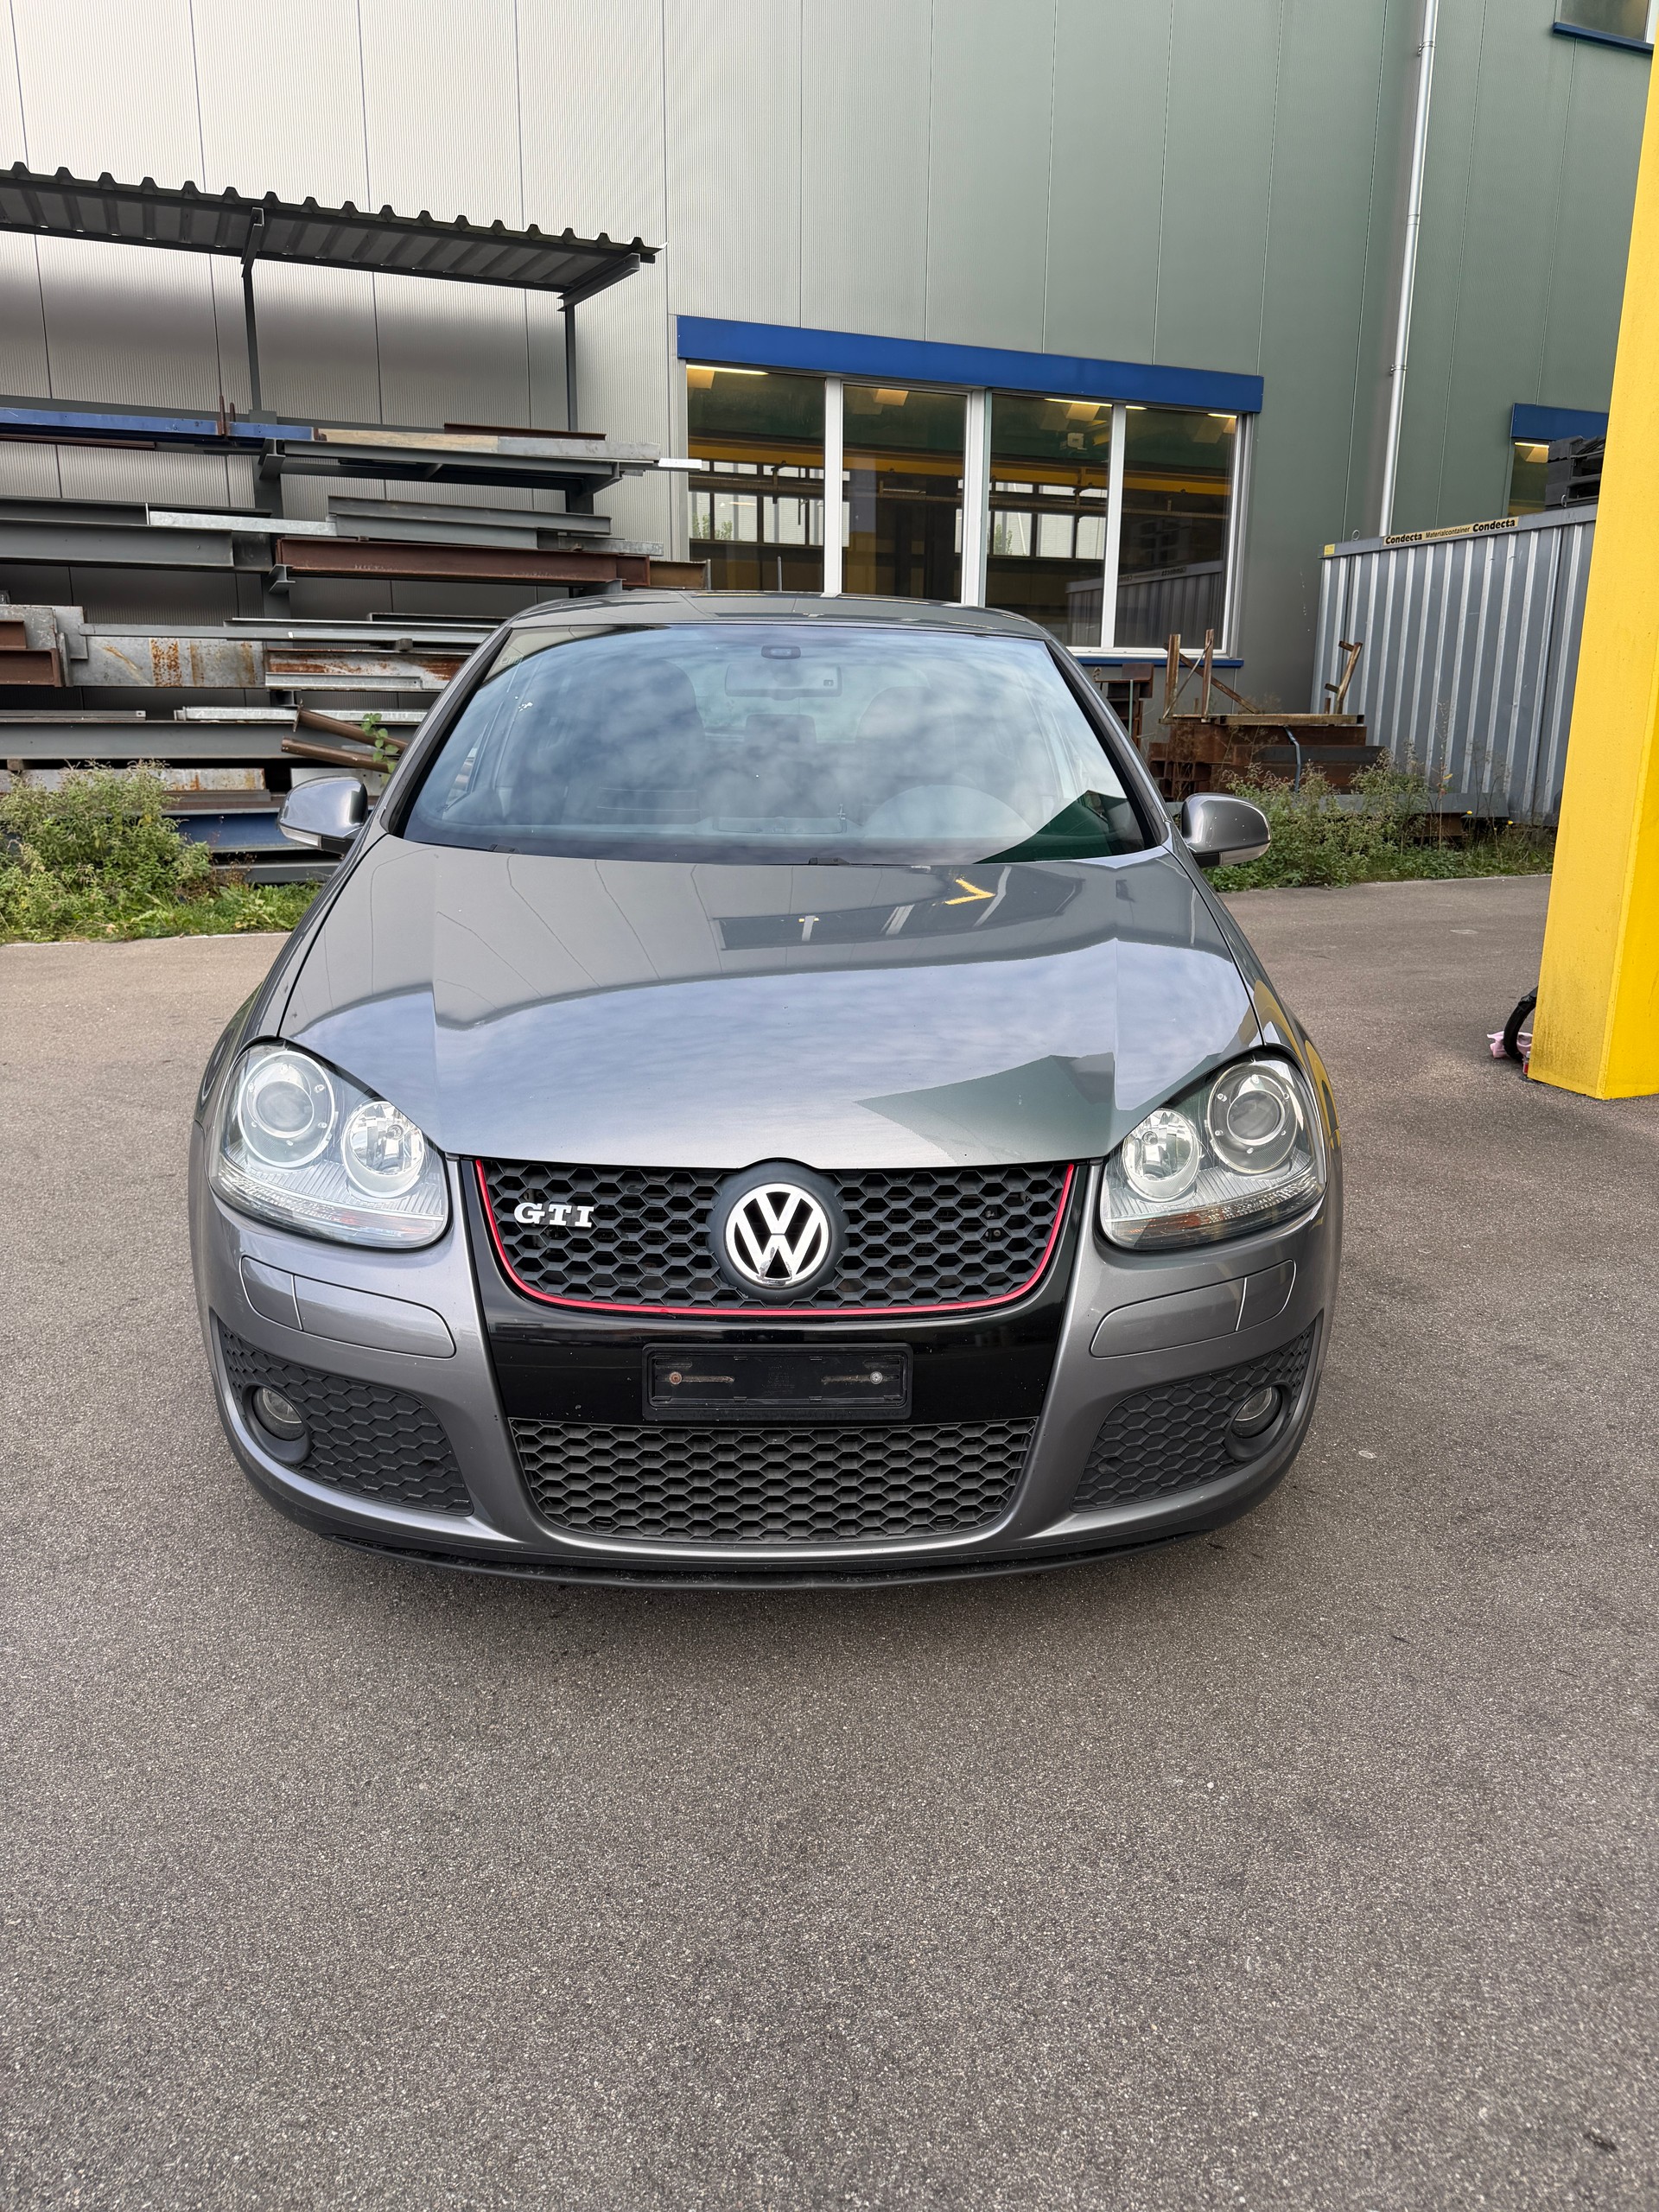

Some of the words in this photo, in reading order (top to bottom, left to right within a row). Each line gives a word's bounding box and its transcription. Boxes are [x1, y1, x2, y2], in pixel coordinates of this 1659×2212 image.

[1385, 533, 1423, 544] Condecta
[1425, 525, 1471, 538] Materialcontainer
[1472, 519, 1516, 532] Condecta
[513, 1202, 594, 1230] GTI
[726, 1182, 831, 1288] VW
